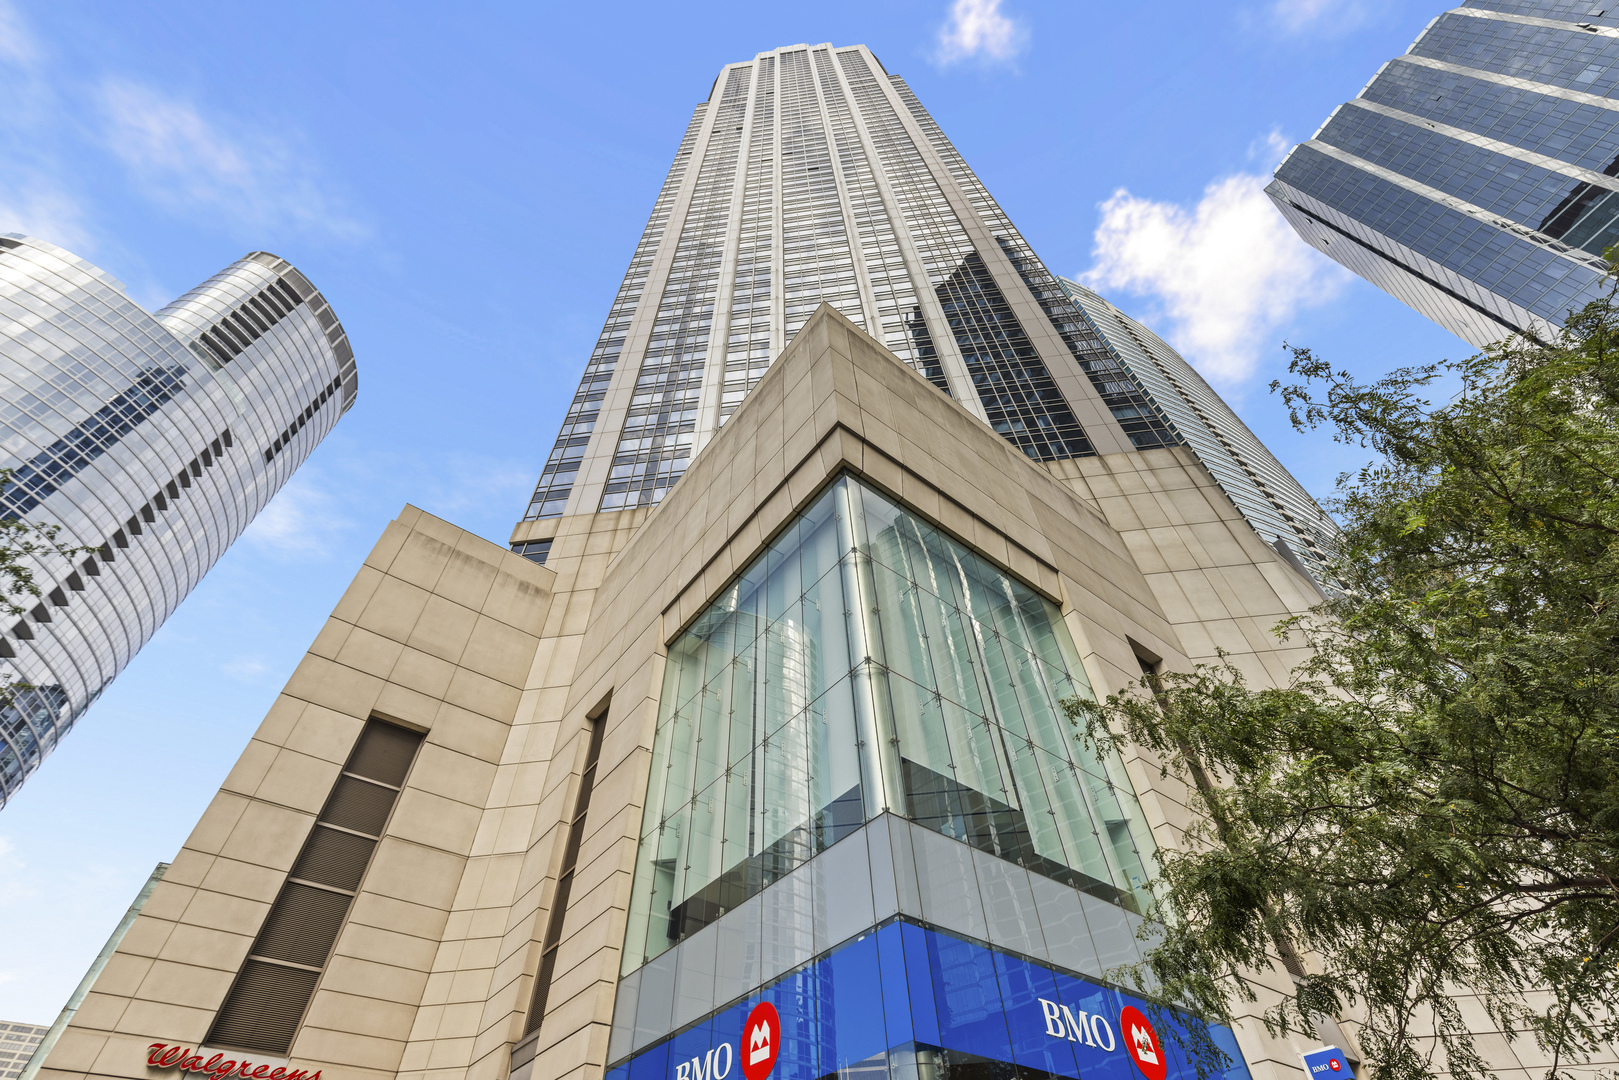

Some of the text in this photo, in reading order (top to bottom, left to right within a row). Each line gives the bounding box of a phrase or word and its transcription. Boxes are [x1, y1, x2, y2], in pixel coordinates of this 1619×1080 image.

[1038, 998, 1116, 1052] BMO
[147, 1043, 322, 1080] Walgreens
[675, 1042, 733, 1080] BMO
[1312, 1064, 1330, 1073] BMO
